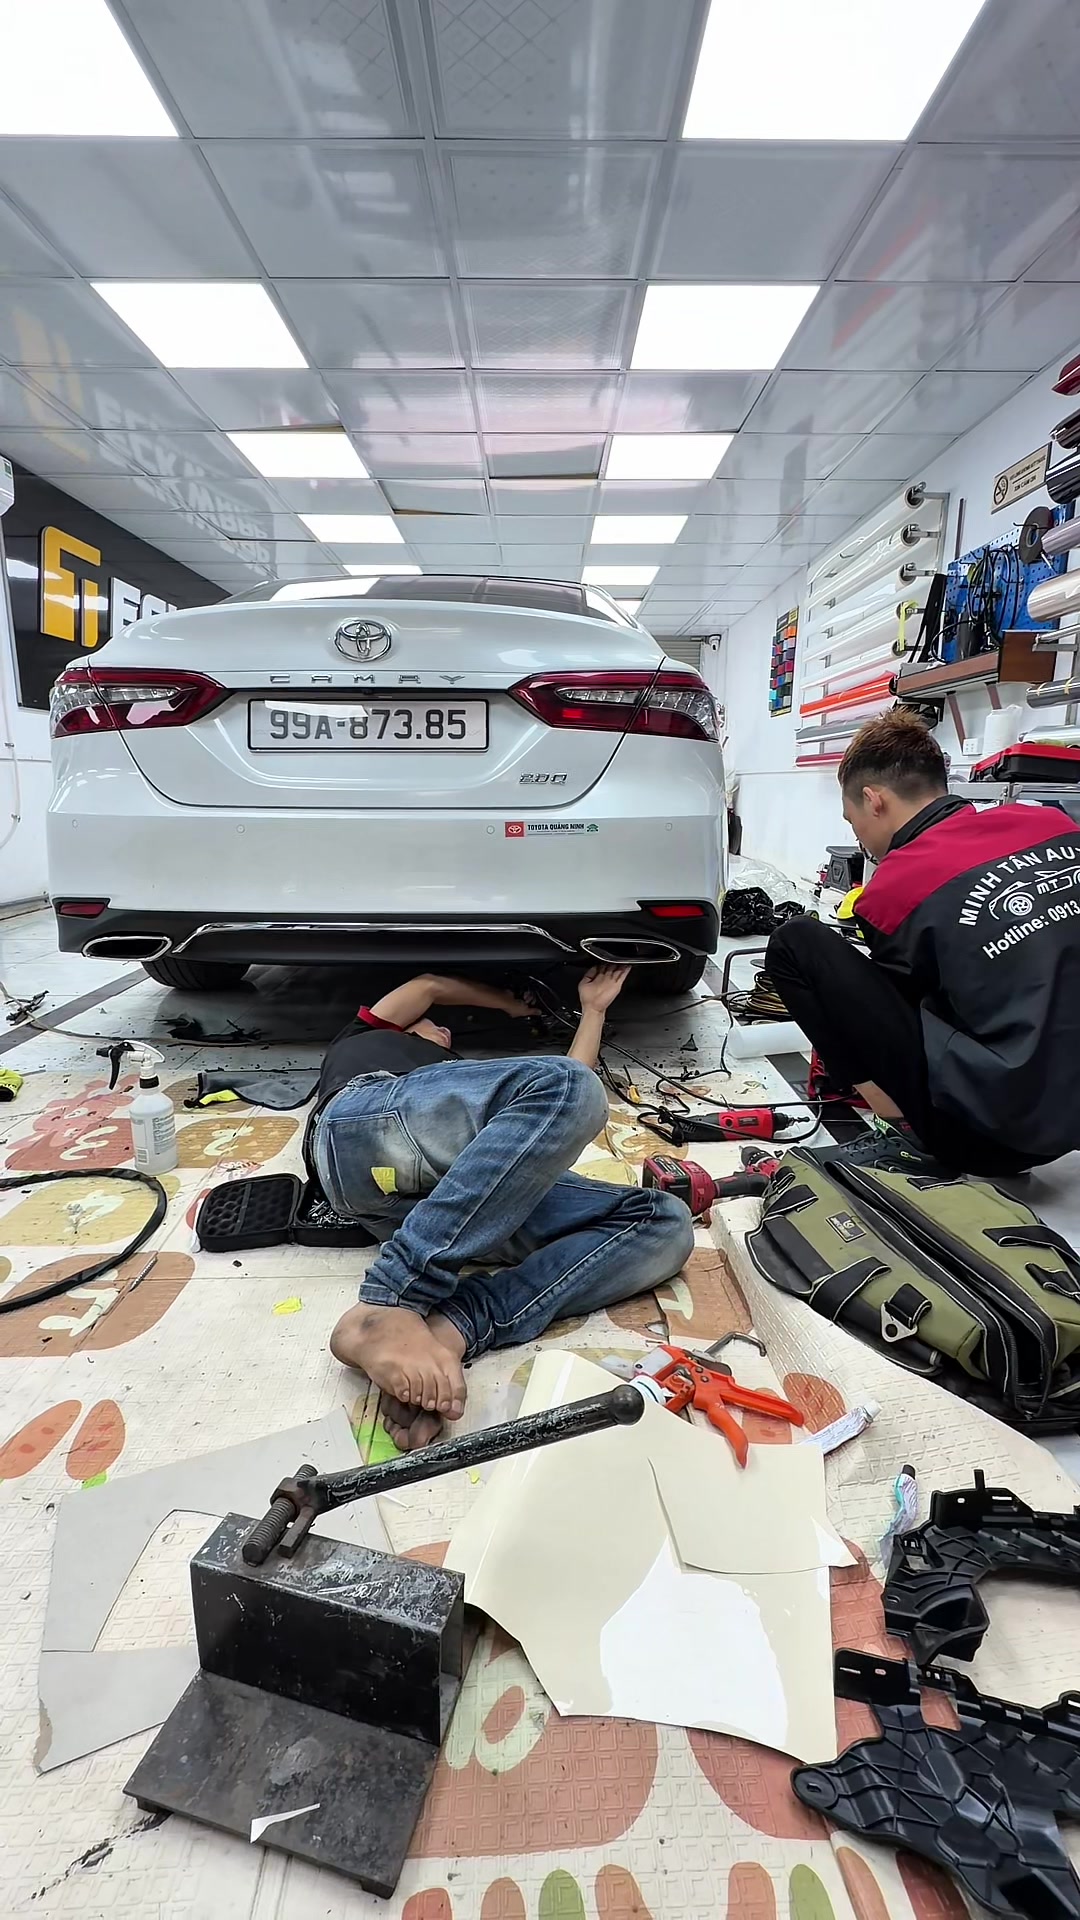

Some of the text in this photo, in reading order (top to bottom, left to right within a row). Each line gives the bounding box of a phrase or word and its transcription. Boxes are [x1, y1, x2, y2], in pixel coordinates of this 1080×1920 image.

[269, 673, 466, 686] CAMRY
[269, 708, 467, 740] 99A-873.85
[958, 846, 1080, 927] MINH TÂN AU
[982, 915, 1050, 960] Hotline:
